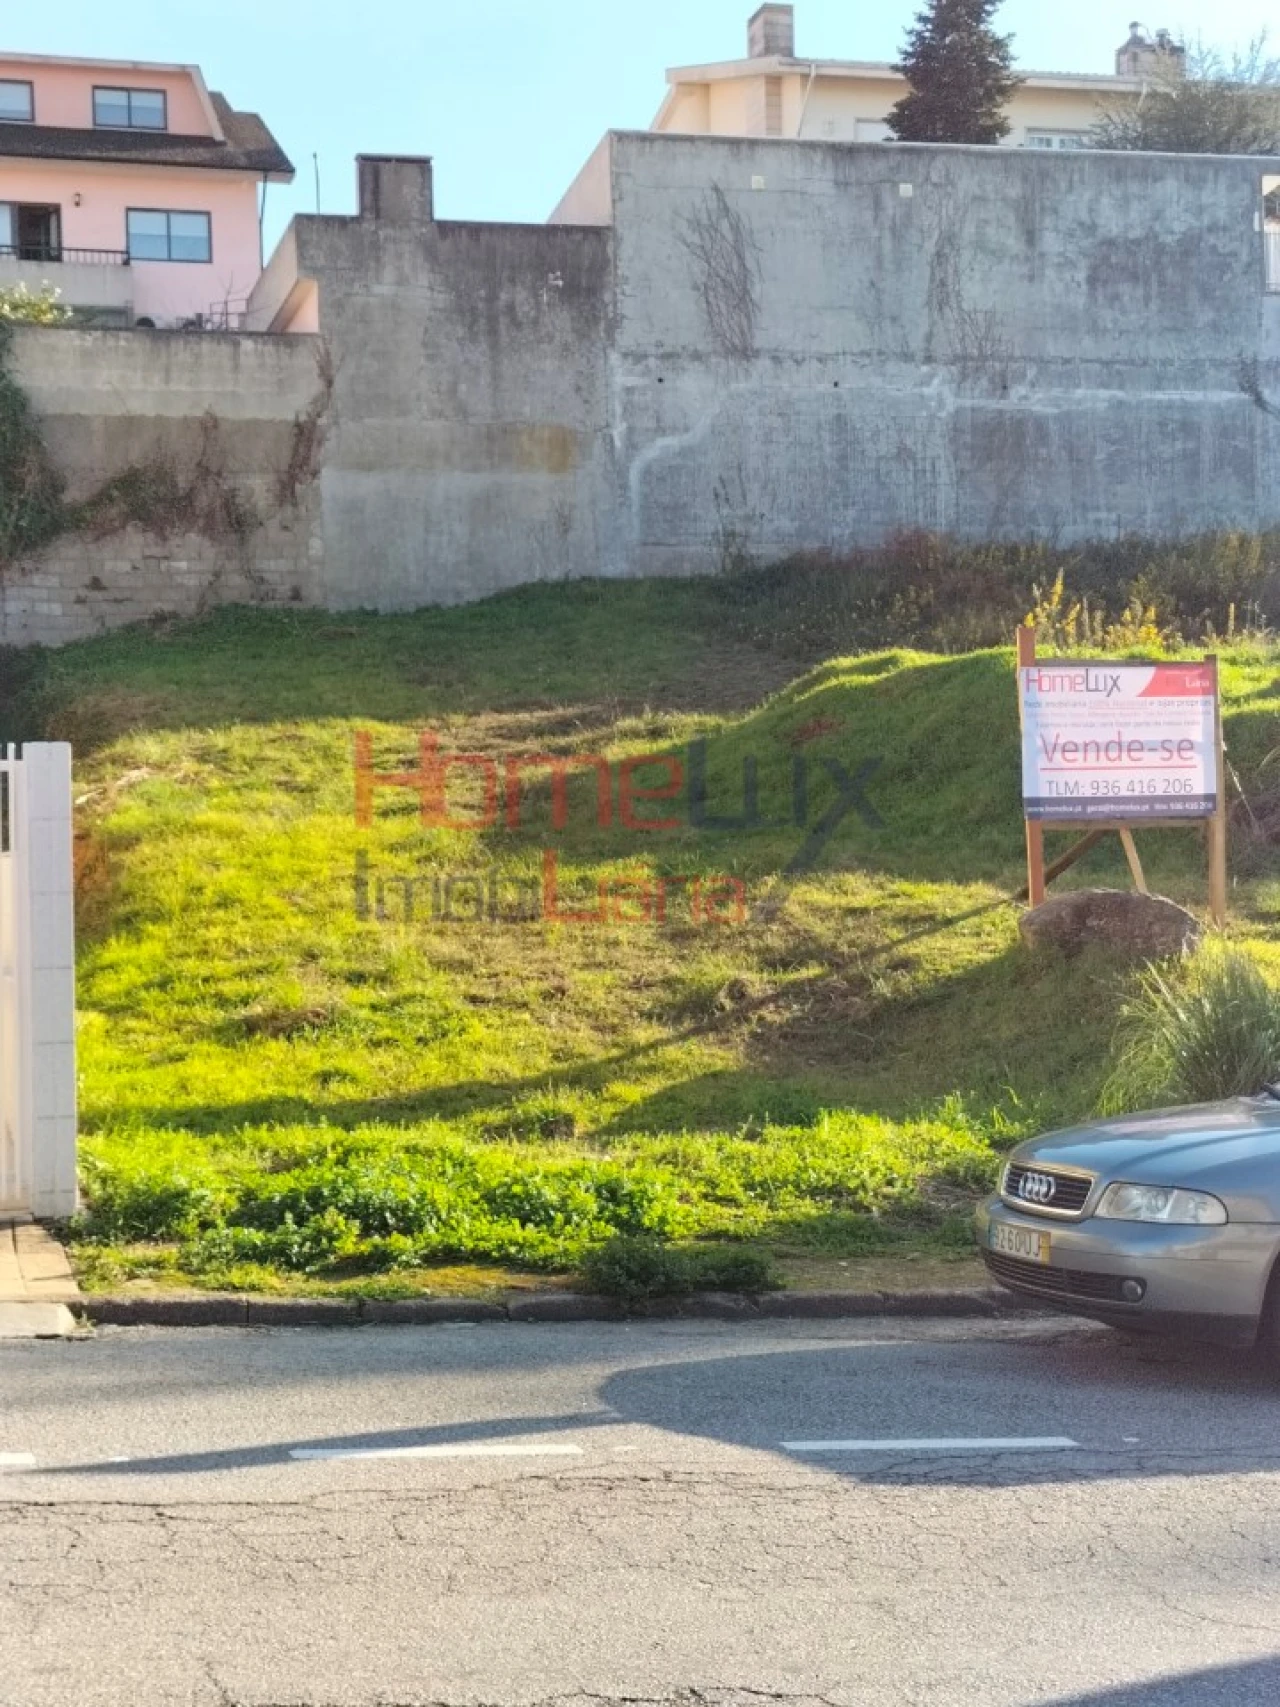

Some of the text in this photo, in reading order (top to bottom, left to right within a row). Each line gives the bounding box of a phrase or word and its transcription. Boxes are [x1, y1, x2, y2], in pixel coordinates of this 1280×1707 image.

[1039, 729, 1195, 763] Vende-se
[1047, 778, 1194, 796] TLM: 936 416 206
